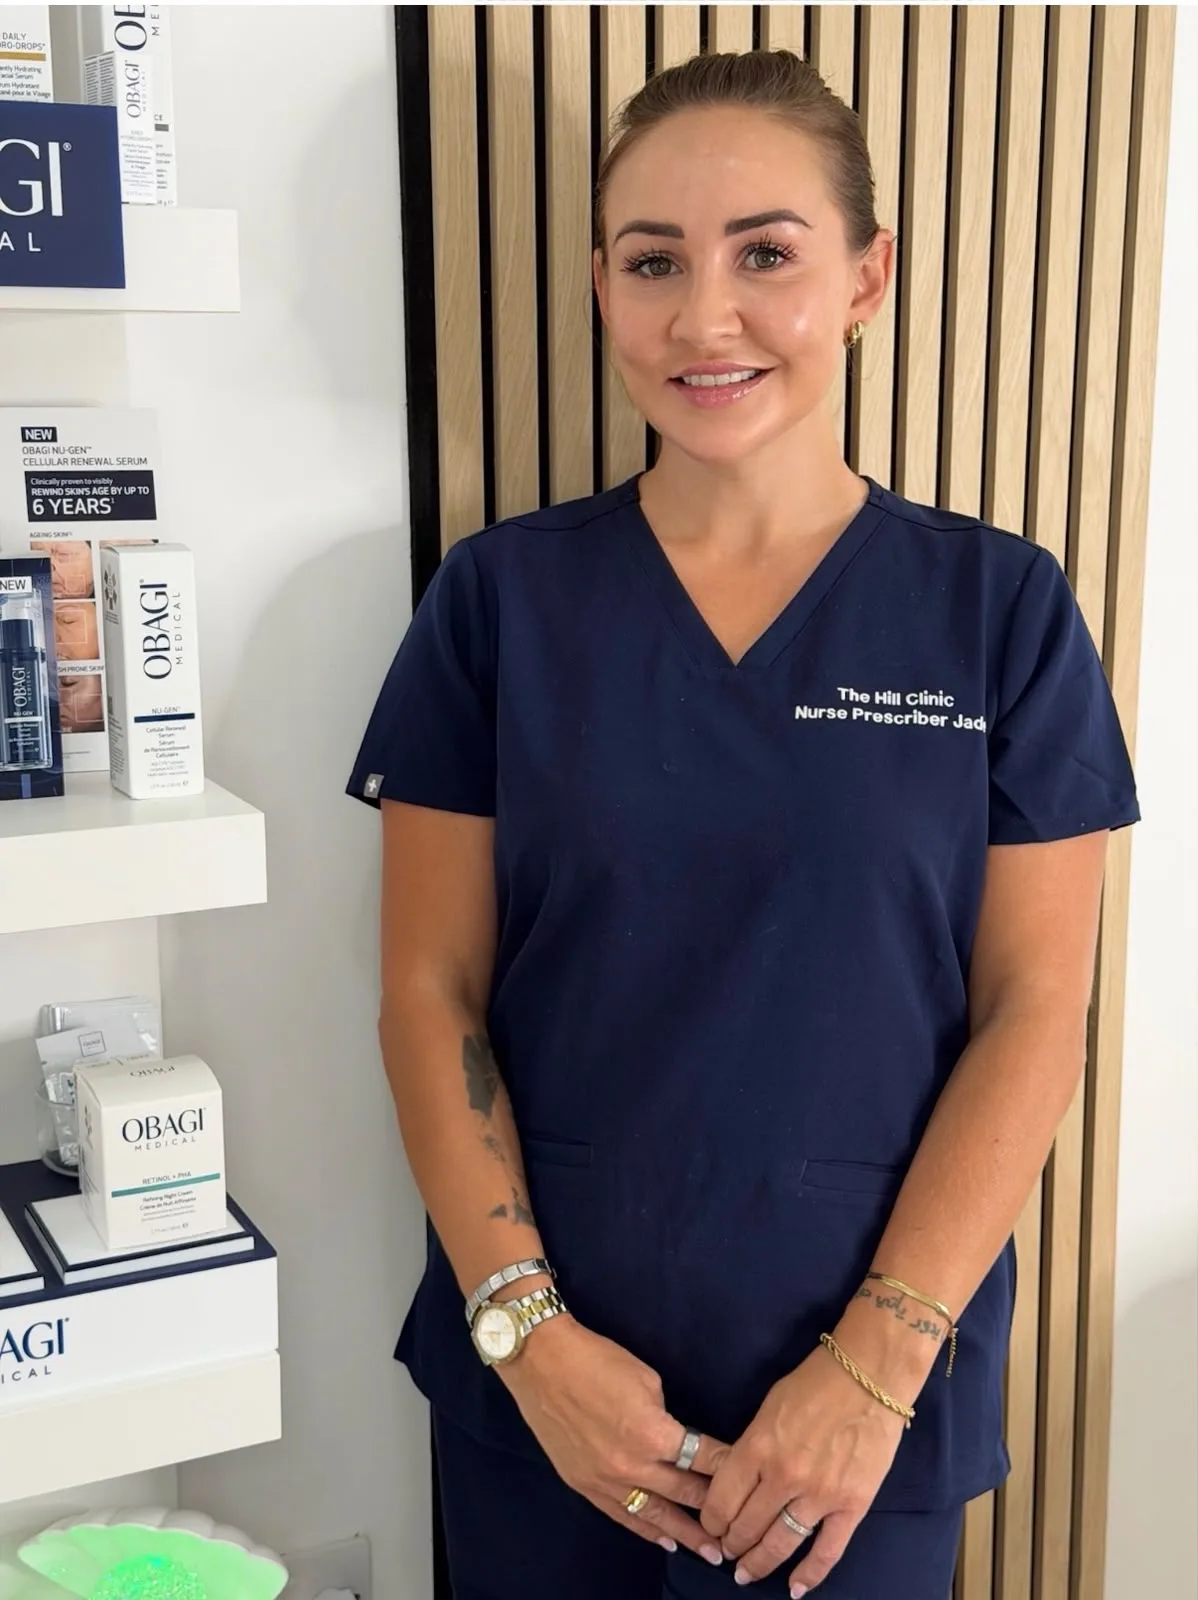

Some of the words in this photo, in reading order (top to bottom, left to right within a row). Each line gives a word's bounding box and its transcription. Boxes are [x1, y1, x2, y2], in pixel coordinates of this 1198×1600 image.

[2, 32, 26, 40] DAILY
[25, 429, 53, 440] NEW
[22, 446, 51, 455] OBAGI
[23, 457, 69, 466] CELLULAR
[71, 457, 114, 466] RENEWAL
[116, 457, 148, 465] SERUM
[30, 478, 60, 487] Clinically
[92, 478, 113, 486] visibly
[31, 487, 64, 496] REWIND
[92, 487, 109, 495] AGE
[110, 486, 123, 495] BY
[124, 486, 136, 494] UP
[138, 486, 150, 495] TO
[32, 498, 45, 515] 6
[0, 580, 26, 591] NEW
[140, 582, 172, 680] OBAGI
[173, 592, 183, 665] MEDICAL
[12, 667, 28, 707] OBAGI
[837, 687, 870, 703] The
[874, 690, 901, 706] Hill
[905, 690, 955, 707] Clinic
[794, 706, 848, 720] Nurse
[852, 707, 949, 727] Prescriber
[122, 1107, 204, 1143] OBAGI
[134, 1136, 196, 1151] MEDICAL
[142, 1175, 171, 1184] RETINOL
